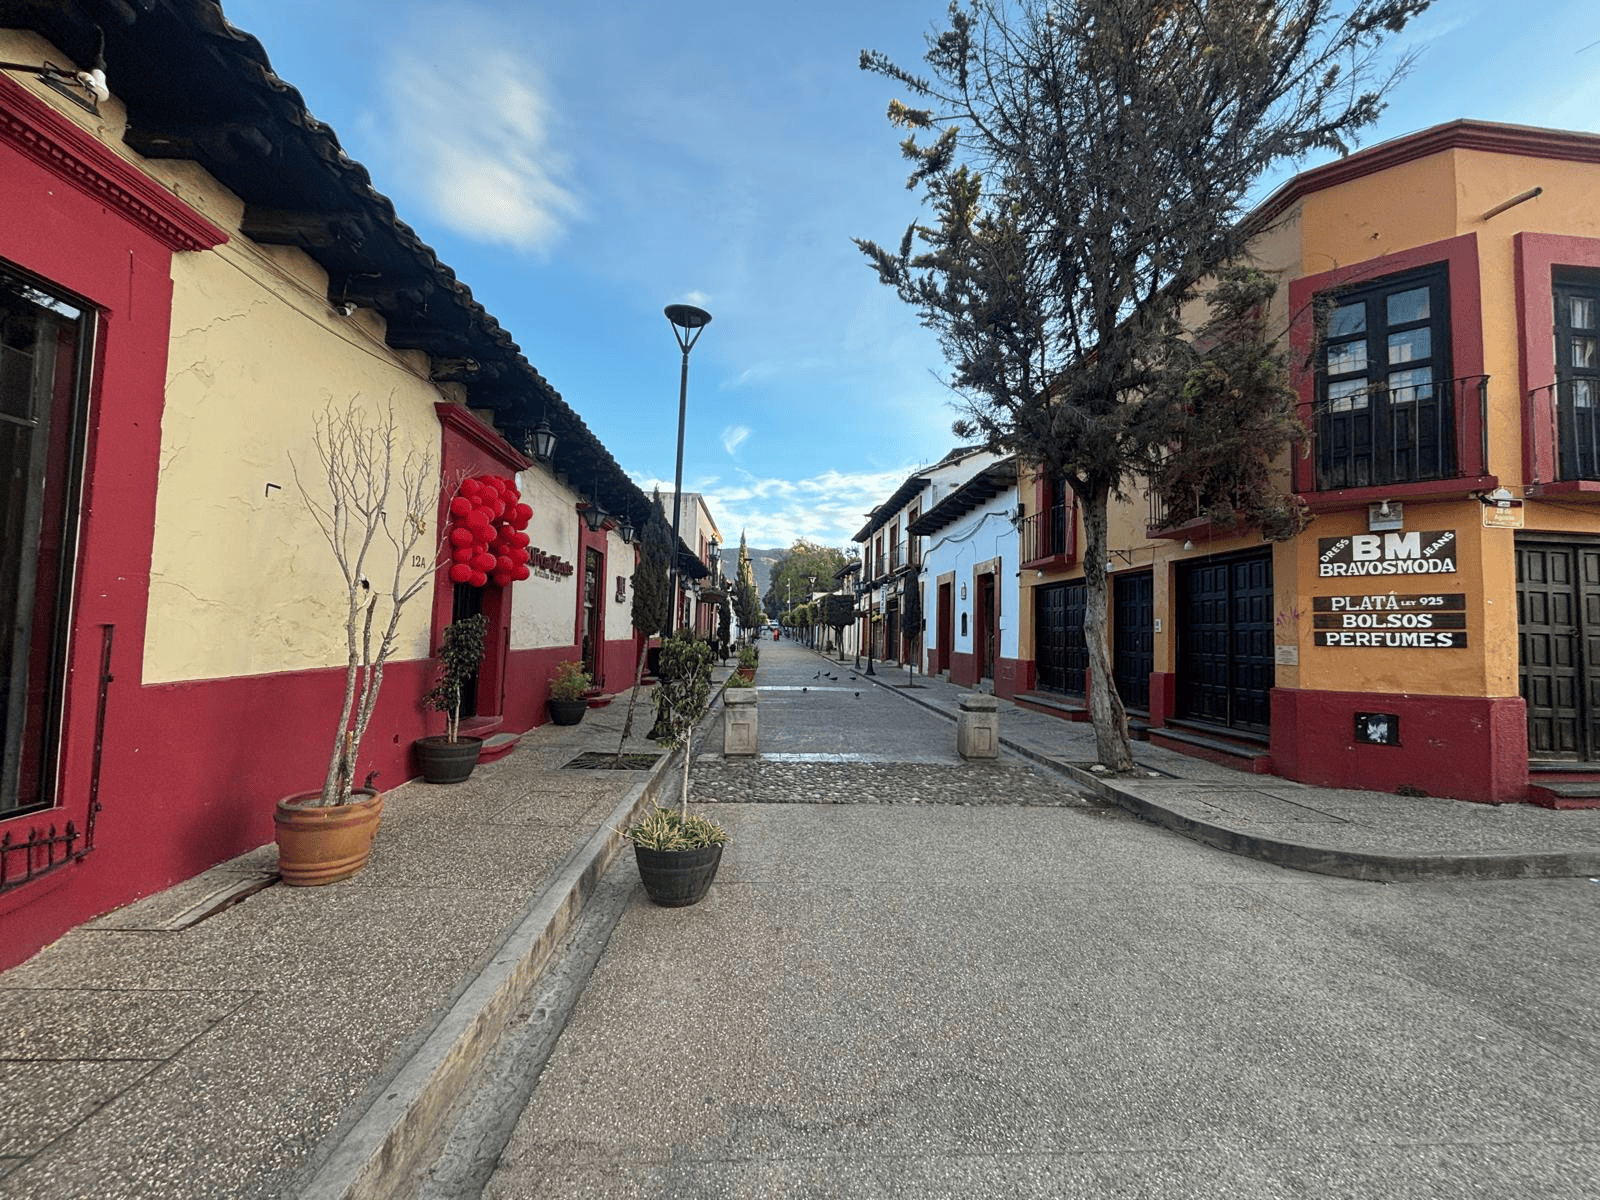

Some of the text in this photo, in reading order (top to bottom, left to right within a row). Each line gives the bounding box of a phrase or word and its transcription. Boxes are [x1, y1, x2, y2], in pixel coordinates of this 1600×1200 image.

[1319, 538, 1350, 563] DRESS
[1352, 531, 1421, 561] BM
[1422, 531, 1455, 558] JEANS
[411, 555, 426, 569] 12A
[1319, 558, 1456, 577] BRAVOSMODA
[1419, 596, 1444, 606] 925
[1342, 613, 1433, 628] BOLSOS
[1326, 632, 1453, 647] PERFUMES
